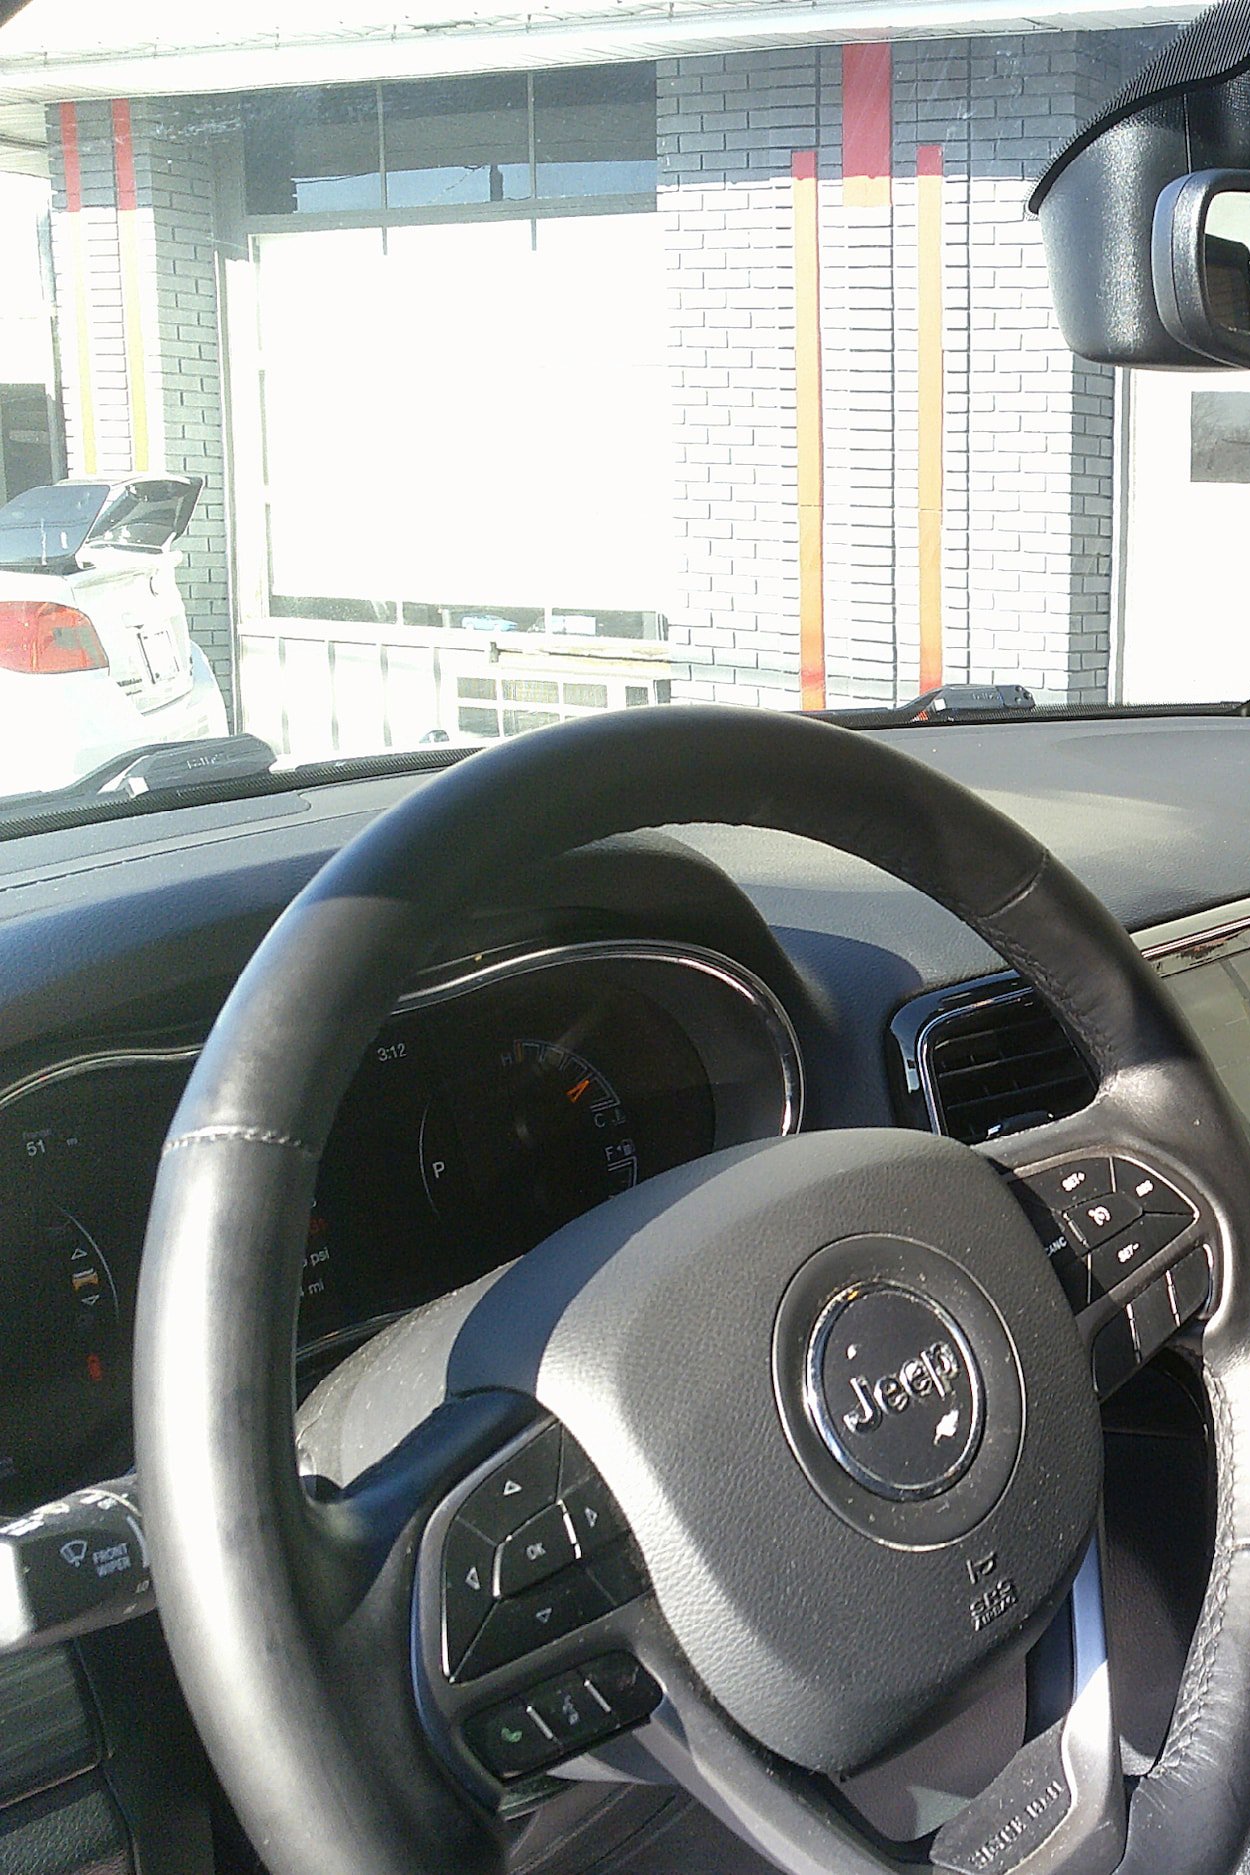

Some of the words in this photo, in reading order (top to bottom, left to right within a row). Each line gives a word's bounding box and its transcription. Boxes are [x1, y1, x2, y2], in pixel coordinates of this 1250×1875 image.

[377, 1043, 407, 1062] 3:12
[594, 1113, 606, 1128] C
[26, 1139, 46, 1157] 51
[605, 1146, 614, 1161] F
[432, 1161, 445, 1178] P
[310, 1246, 330, 1267] psi
[308, 1279, 325, 1294] mi
[843, 1341, 959, 1434] Jeep
[526, 1542, 546, 1560] OK
